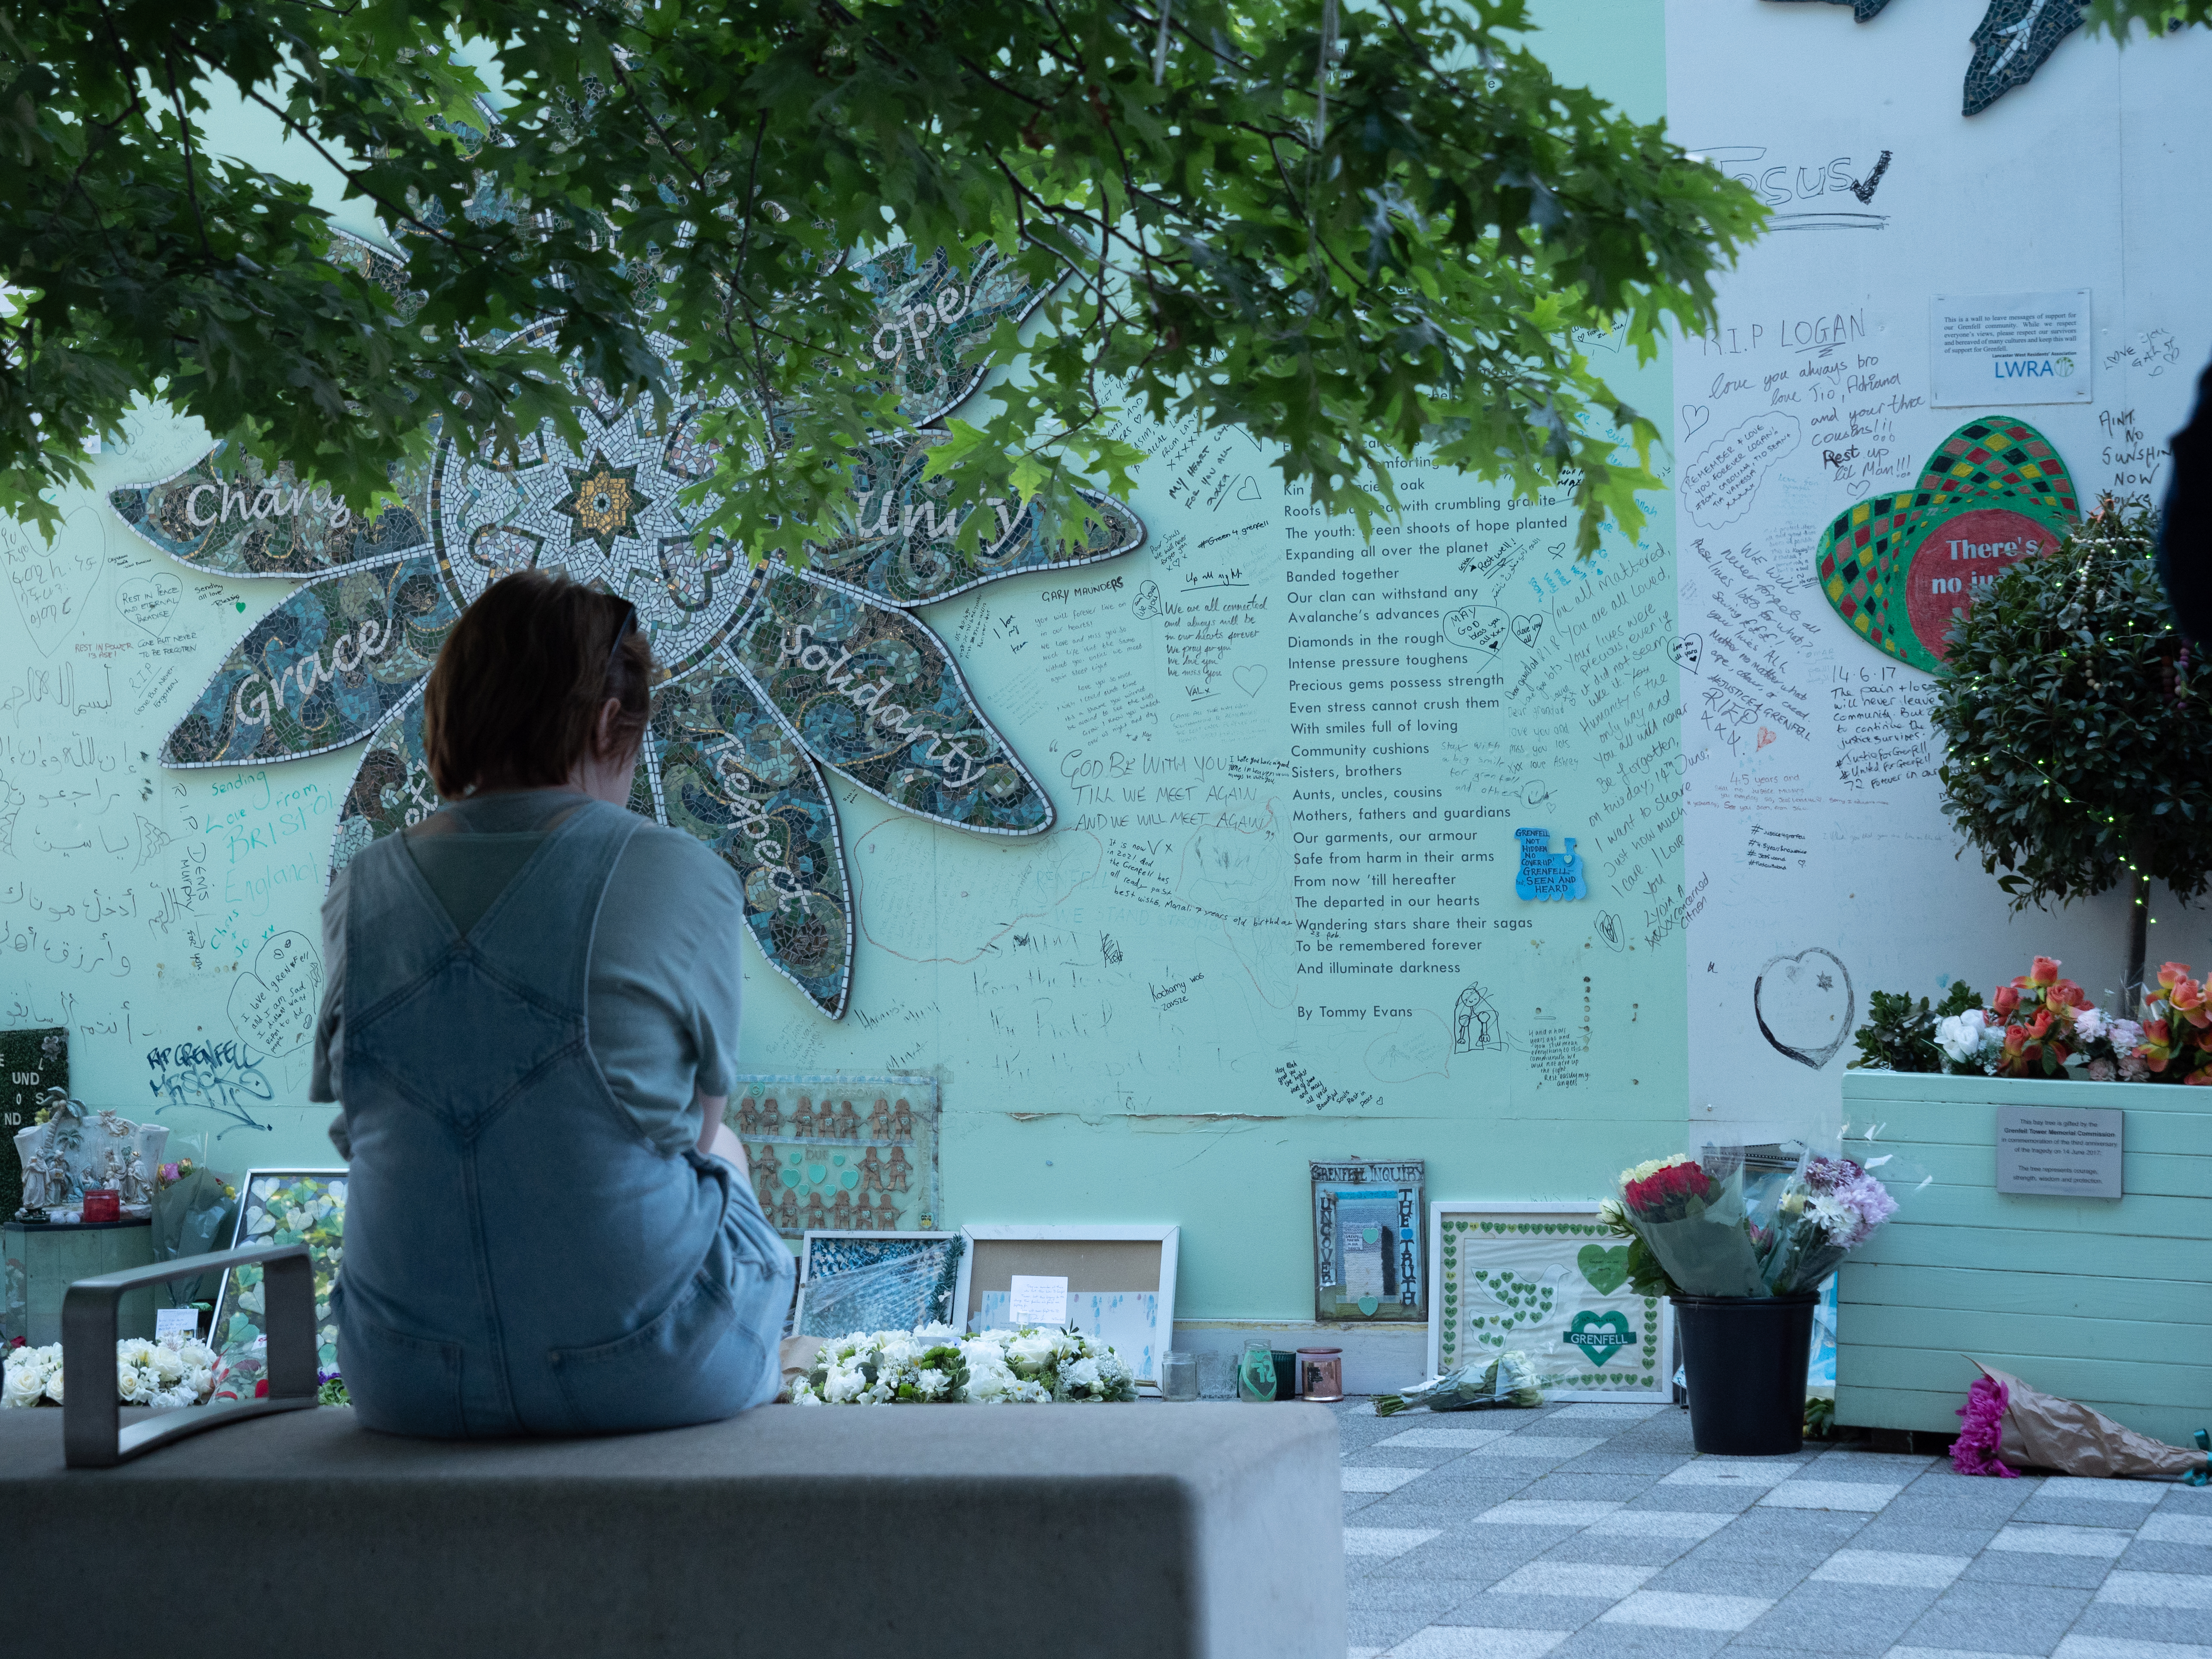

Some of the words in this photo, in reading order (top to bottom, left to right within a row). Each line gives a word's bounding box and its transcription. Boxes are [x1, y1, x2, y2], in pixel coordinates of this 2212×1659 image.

[1782, 308, 1865, 345] LOGAN
[1995, 360, 2054, 378] LWRA
[2126, 427, 2144, 442] NO
[2114, 464, 2160, 486] NOW
[1284, 505, 1321, 517] Roots
[1401, 499, 1429, 511] with
[1435, 496, 1501, 511] crumbling
[1285, 527, 1308, 539] The
[1314, 524, 1355, 541] youth:
[1362, 525, 1400, 539] reen
[1407, 521, 1450, 534] shoots
[1456, 519, 1470, 533] of
[1476, 519, 1510, 534] hope
[1516, 515, 1567, 533] planted
[1286, 548, 1354, 563] Expanding
[1361, 545, 1375, 558] all
[1381, 547, 1412, 556] over
[1418, 542, 1440, 555] the
[1446, 541, 1488, 557] planet
[1946, 537, 2038, 560] There's
[1286, 568, 1336, 582] Banded
[1342, 567, 1400, 583] together
[122, 593, 142, 604] REST
[155, 584, 179, 597] PEACE
[1042, 590, 1069, 603] GARY
[1074, 577, 1123, 597] MAUNDERS
[1287, 591, 1313, 604] Our
[1319, 590, 1346, 602] clan
[1351, 592, 1375, 601] can
[1382, 585, 1447, 600] withstand
[1454, 588, 1479, 600] any
[1932, 577, 1962, 594] no
[1288, 609, 1369, 623] Avalanche's
[1376, 607, 1440, 620] advances
[157, 637, 171, 646] BUT
[173, 633, 197, 642] NEVER
[1288, 658, 1336, 669] Intense
[1342, 658, 1400, 671] pressure
[1406, 652, 1468, 668] toughens
[236, 617, 391, 726] Grace
[1831, 688, 1854, 699] The
[1861, 684, 1895, 700] pain
[781, 626, 987, 789] Solidarity
[1290, 722, 1319, 734] With
[1326, 721, 1365, 734] smiles
[1371, 720, 1391, 733] full
[1397, 719, 1412, 732] of
[1417, 719, 1458, 733] loving
[1291, 745, 1367, 758] Community
[1373, 742, 1429, 755] cushions
[1060, 749, 1103, 787] GOD
[1109, 752, 1135, 778] BE
[1194, 755, 1226, 782] YOU
[1292, 766, 1339, 780] Sisters,
[1345, 764, 1402, 777] brothers
[212, 771, 270, 810] Sending
[1292, 789, 1335, 802] Aunts,
[1341, 786, 1387, 801] uncles,
[1394, 789, 1442, 798] cousins
[204, 810, 246, 833] Love
[705, 732, 813, 916] Respect
[1293, 832, 1319, 844] Our
[1325, 831, 1393, 846] garments,
[1399, 833, 1422, 842] our
[1428, 832, 1478, 841] armour
[224, 853, 319, 916] England
[1294, 875, 1326, 887] From
[1332, 878, 1360, 887] now
[1367, 873, 1386, 886] 'till
[1392, 872, 1456, 886] hereafter
[1526, 877, 1554, 885] SEEN
[1535, 885, 1568, 893] HEARD
[1295, 896, 1317, 908] The
[1324, 894, 1384, 911] departed
[1391, 898, 1402, 907] in
[1408, 898, 1431, 907] our
[1437, 894, 1480, 906] hearts
[1295, 940, 1311, 952] To
[1317, 939, 1333, 952] be
[1339, 938, 1425, 952] remembered
[1432, 938, 1482, 951] forever
[1296, 961, 1323, 974] And
[1330, 961, 1393, 974] illuminate
[1400, 960, 1461, 973] darkness
[1149, 982, 1186, 1003] Kochamy
[1190, 973, 1205, 983] was
[1298, 1006, 1313, 1021] By
[1319, 1006, 1367, 1020] Tommy
[1373, 1005, 1413, 1017] Evans
[147, 1048, 172, 1072] RIP
[173, 1039, 263, 1068] GRENFELL
[1311, 1165, 1367, 1181] GRENFELL
[1368, 1164, 1424, 1182] INQUIRY
[1399, 1188, 1413, 1228] THE
[1320, 1197, 1333, 1284] UNCOVER
[1400, 1240, 1416, 1306] TRUTH
[1571, 1333, 1628, 1344] GRENFELL
